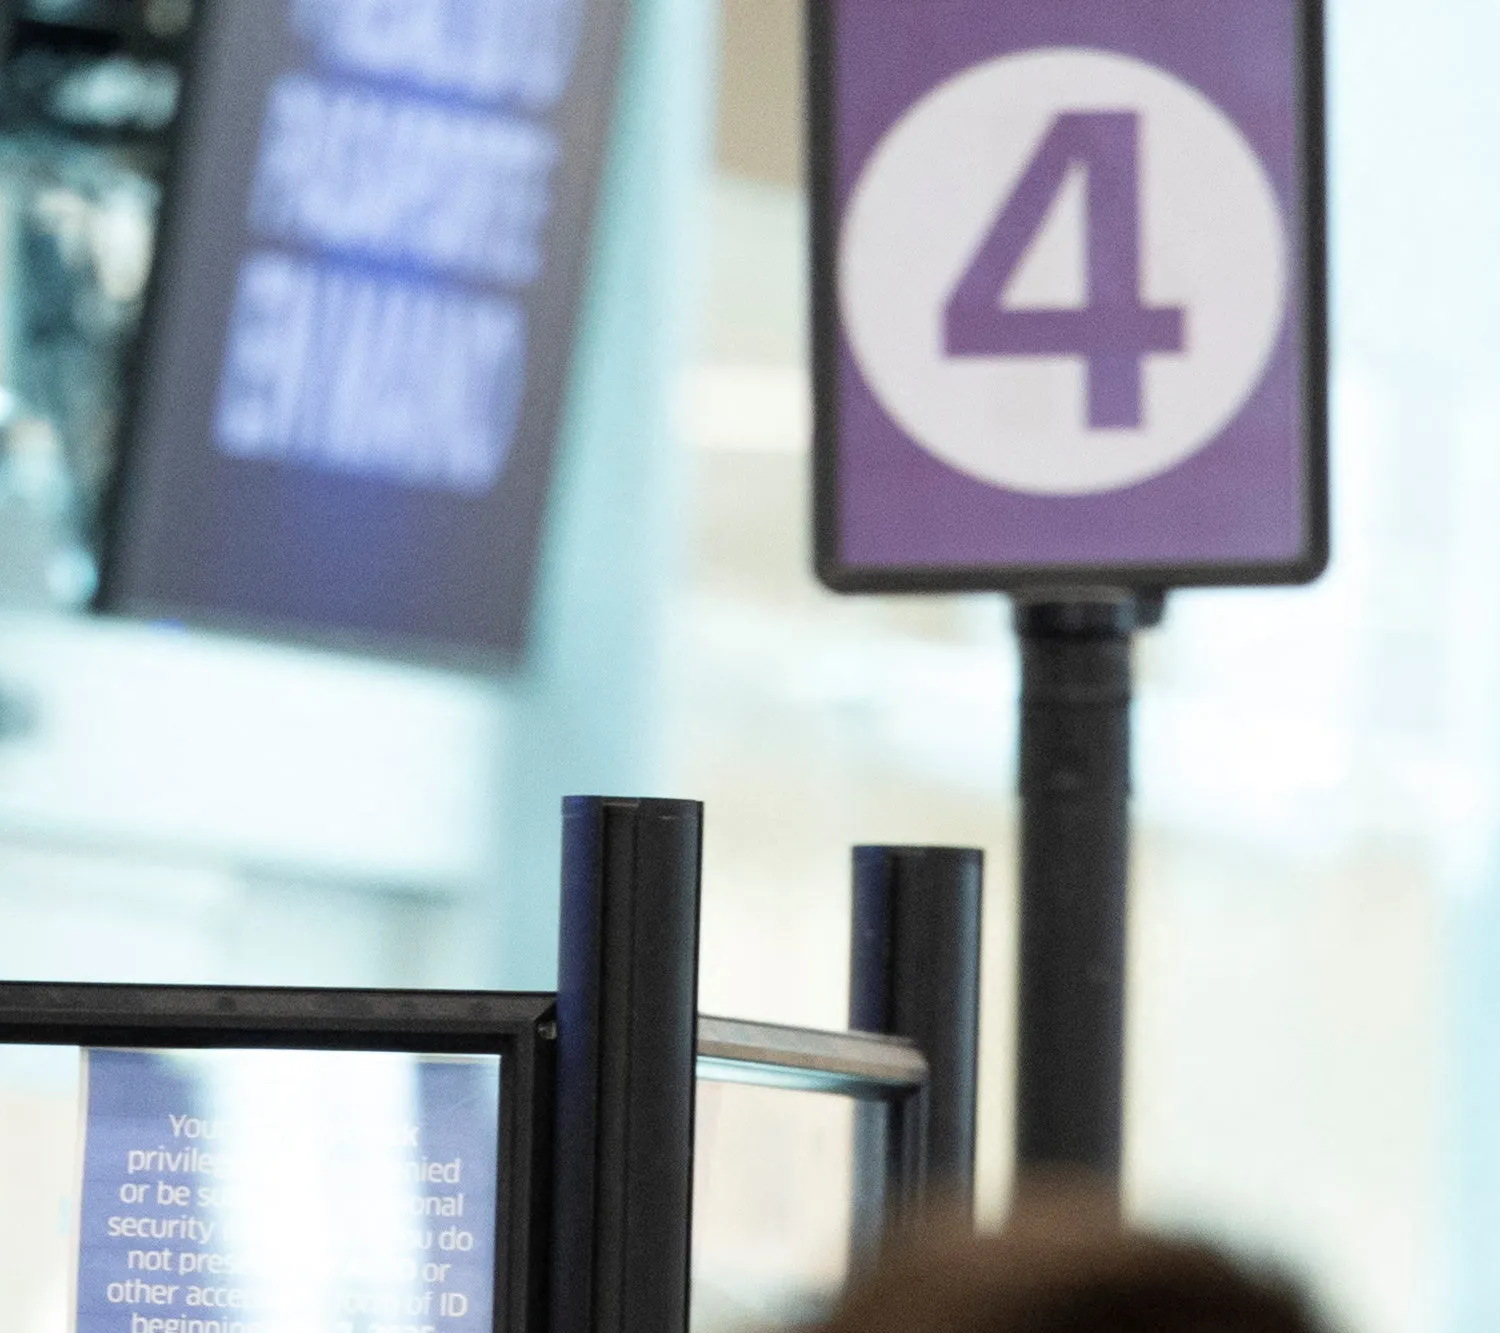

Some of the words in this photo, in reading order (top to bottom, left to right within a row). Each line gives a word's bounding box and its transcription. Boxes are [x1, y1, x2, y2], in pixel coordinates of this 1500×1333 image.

[942, 111, 1186, 429] 4
[119, 1182, 151, 1205] or
[157, 1180, 192, 1207] be
[107, 1215, 216, 1244] security
[439, 1225, 474, 1252] do
[127, 1249, 172, 1272] not
[422, 1262, 452, 1284] or
[106, 1278, 181, 1306] other
[438, 1292, 470, 1318] ID
